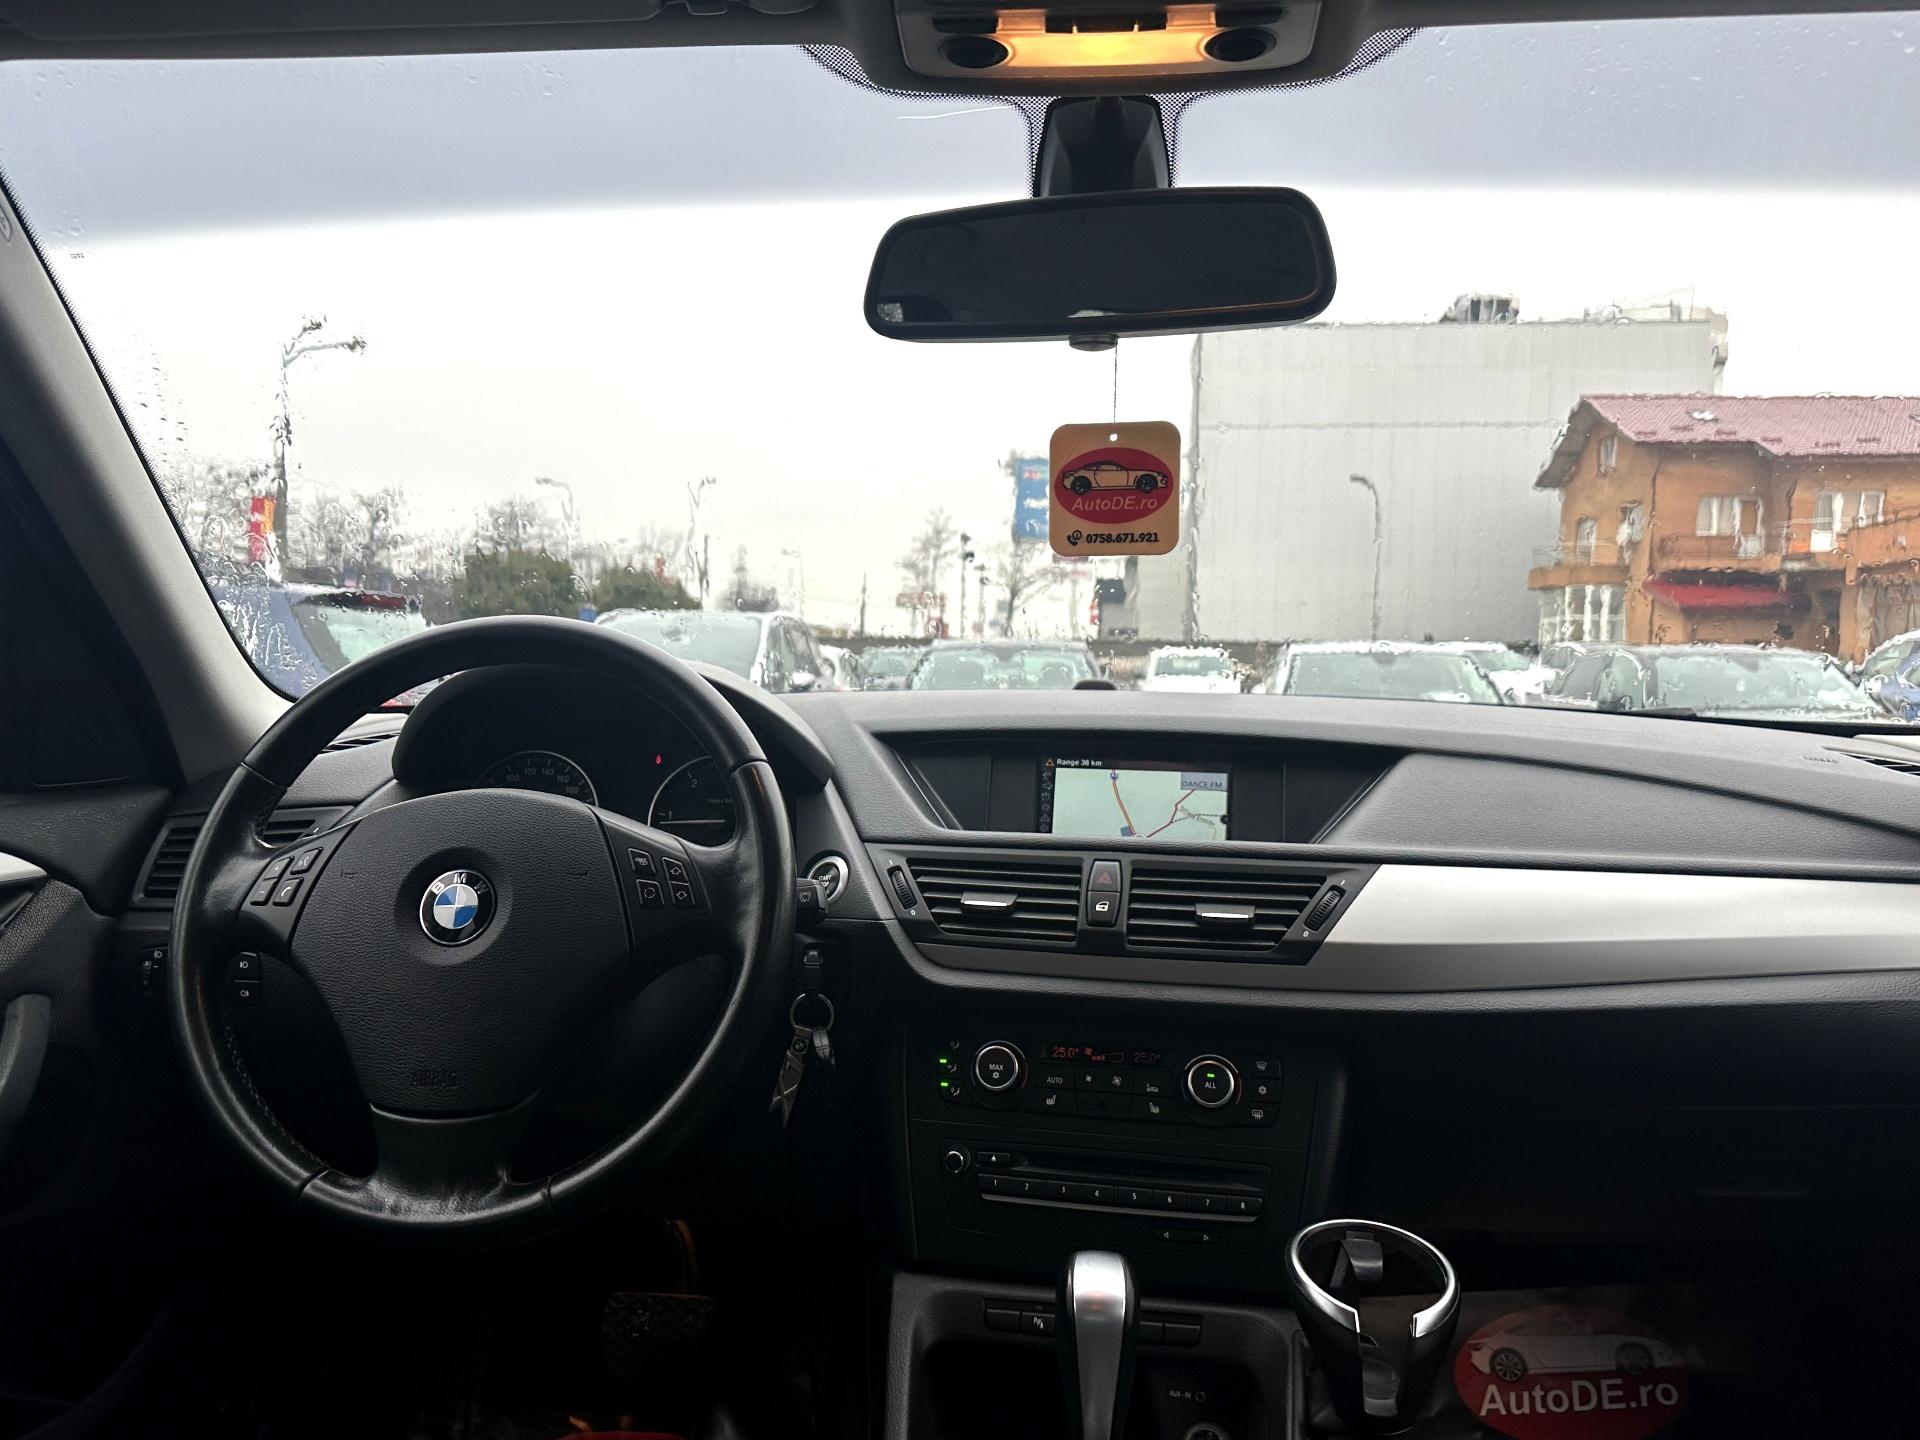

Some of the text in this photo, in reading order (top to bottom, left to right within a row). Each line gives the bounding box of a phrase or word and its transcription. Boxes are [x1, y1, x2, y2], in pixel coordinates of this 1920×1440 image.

[1071, 496, 1158, 511] AutoDE.ro
[1086, 532, 1160, 544] 0758.671.921
[1056, 758, 1079, 767] Range
[690, 778, 698, 788] 2
[1183, 780, 1209, 788] DANCE
[431, 873, 489, 895] BMW
[988, 1063, 1004, 1071] MAX
[1046, 1076, 1063, 1085] AUTO
[1204, 1081, 1217, 1089] ALL
[1478, 1378, 1680, 1418] AutoDE.ro
